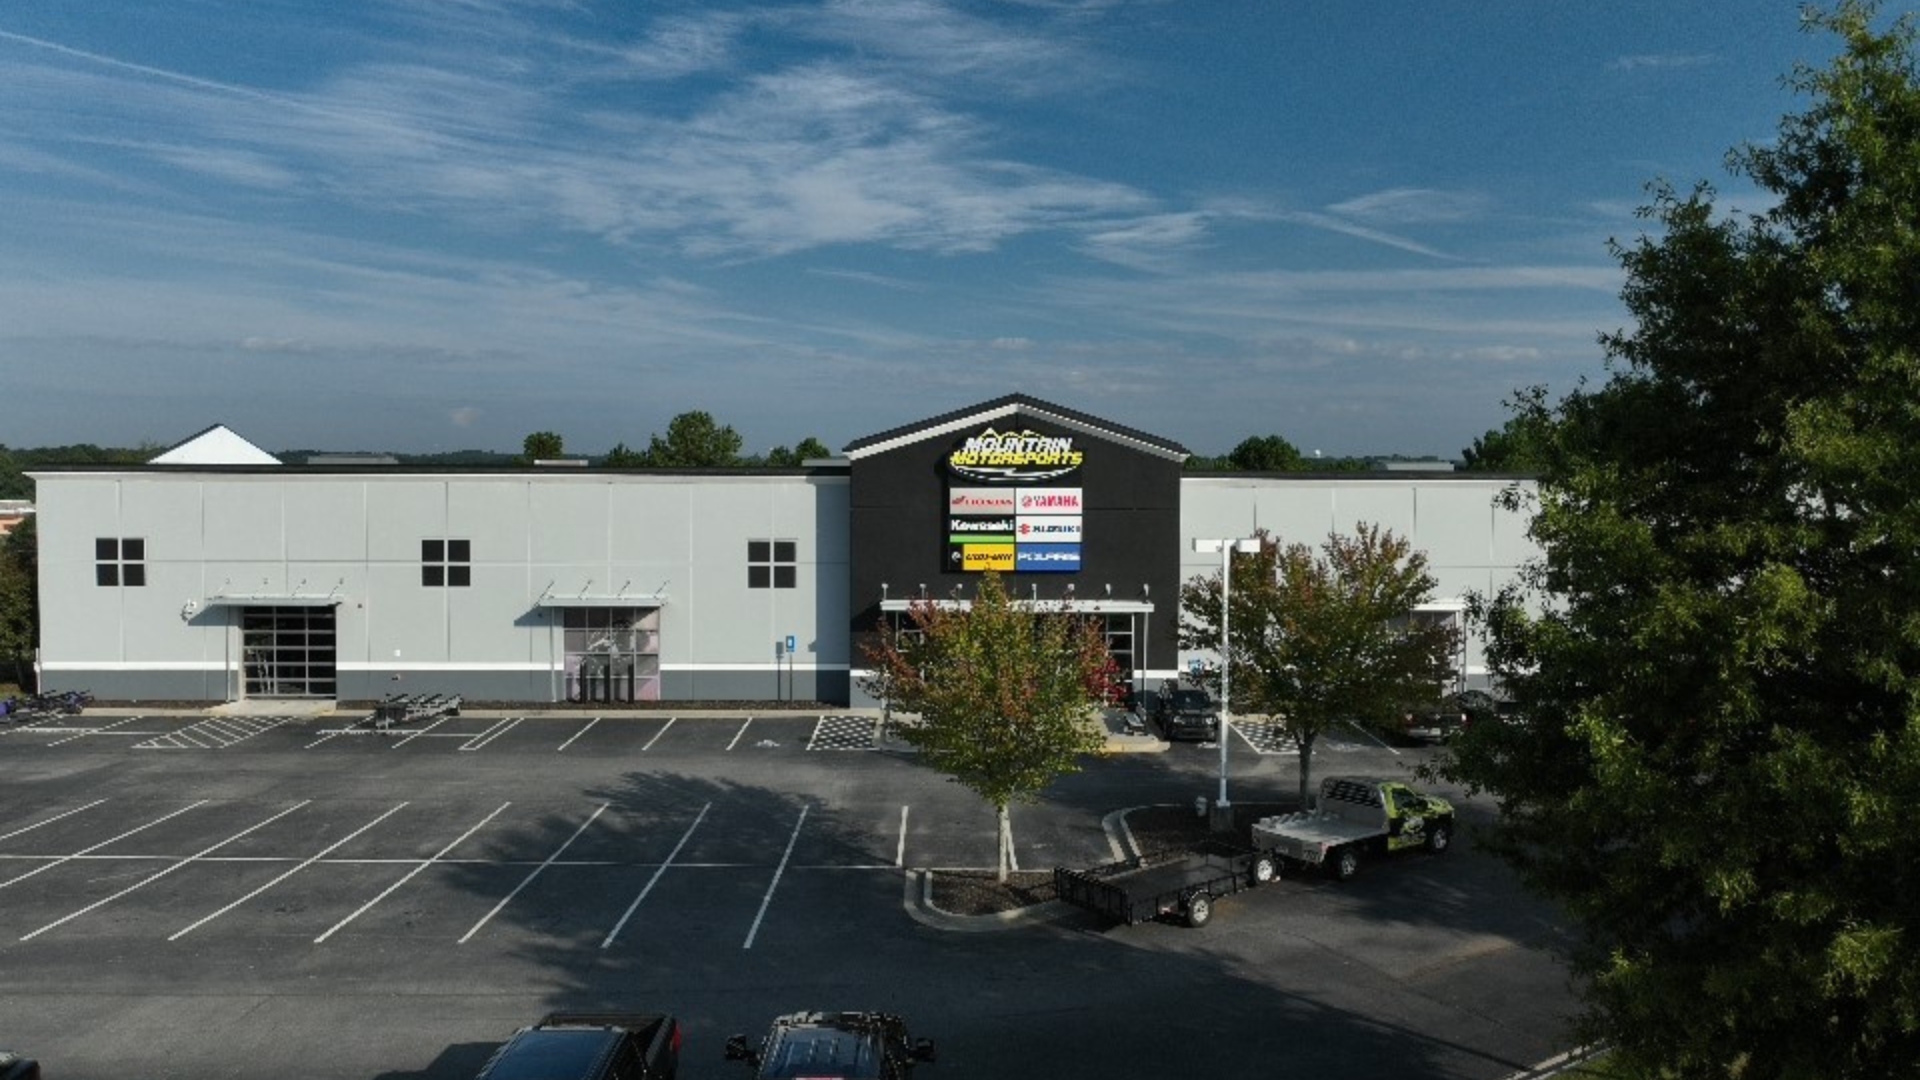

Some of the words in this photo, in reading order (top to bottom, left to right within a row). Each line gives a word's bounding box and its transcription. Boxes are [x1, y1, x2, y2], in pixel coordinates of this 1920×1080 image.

[963, 437, 1073, 453] MOUNTAIN
[951, 451, 1083, 465] MOTORSPORTS
[1034, 495, 1079, 507] YAMAHA
[951, 519, 1014, 531] Kawasaki
[1032, 525, 1080, 533] SUZUKI
[1017, 552, 1080, 561] POLARIS
